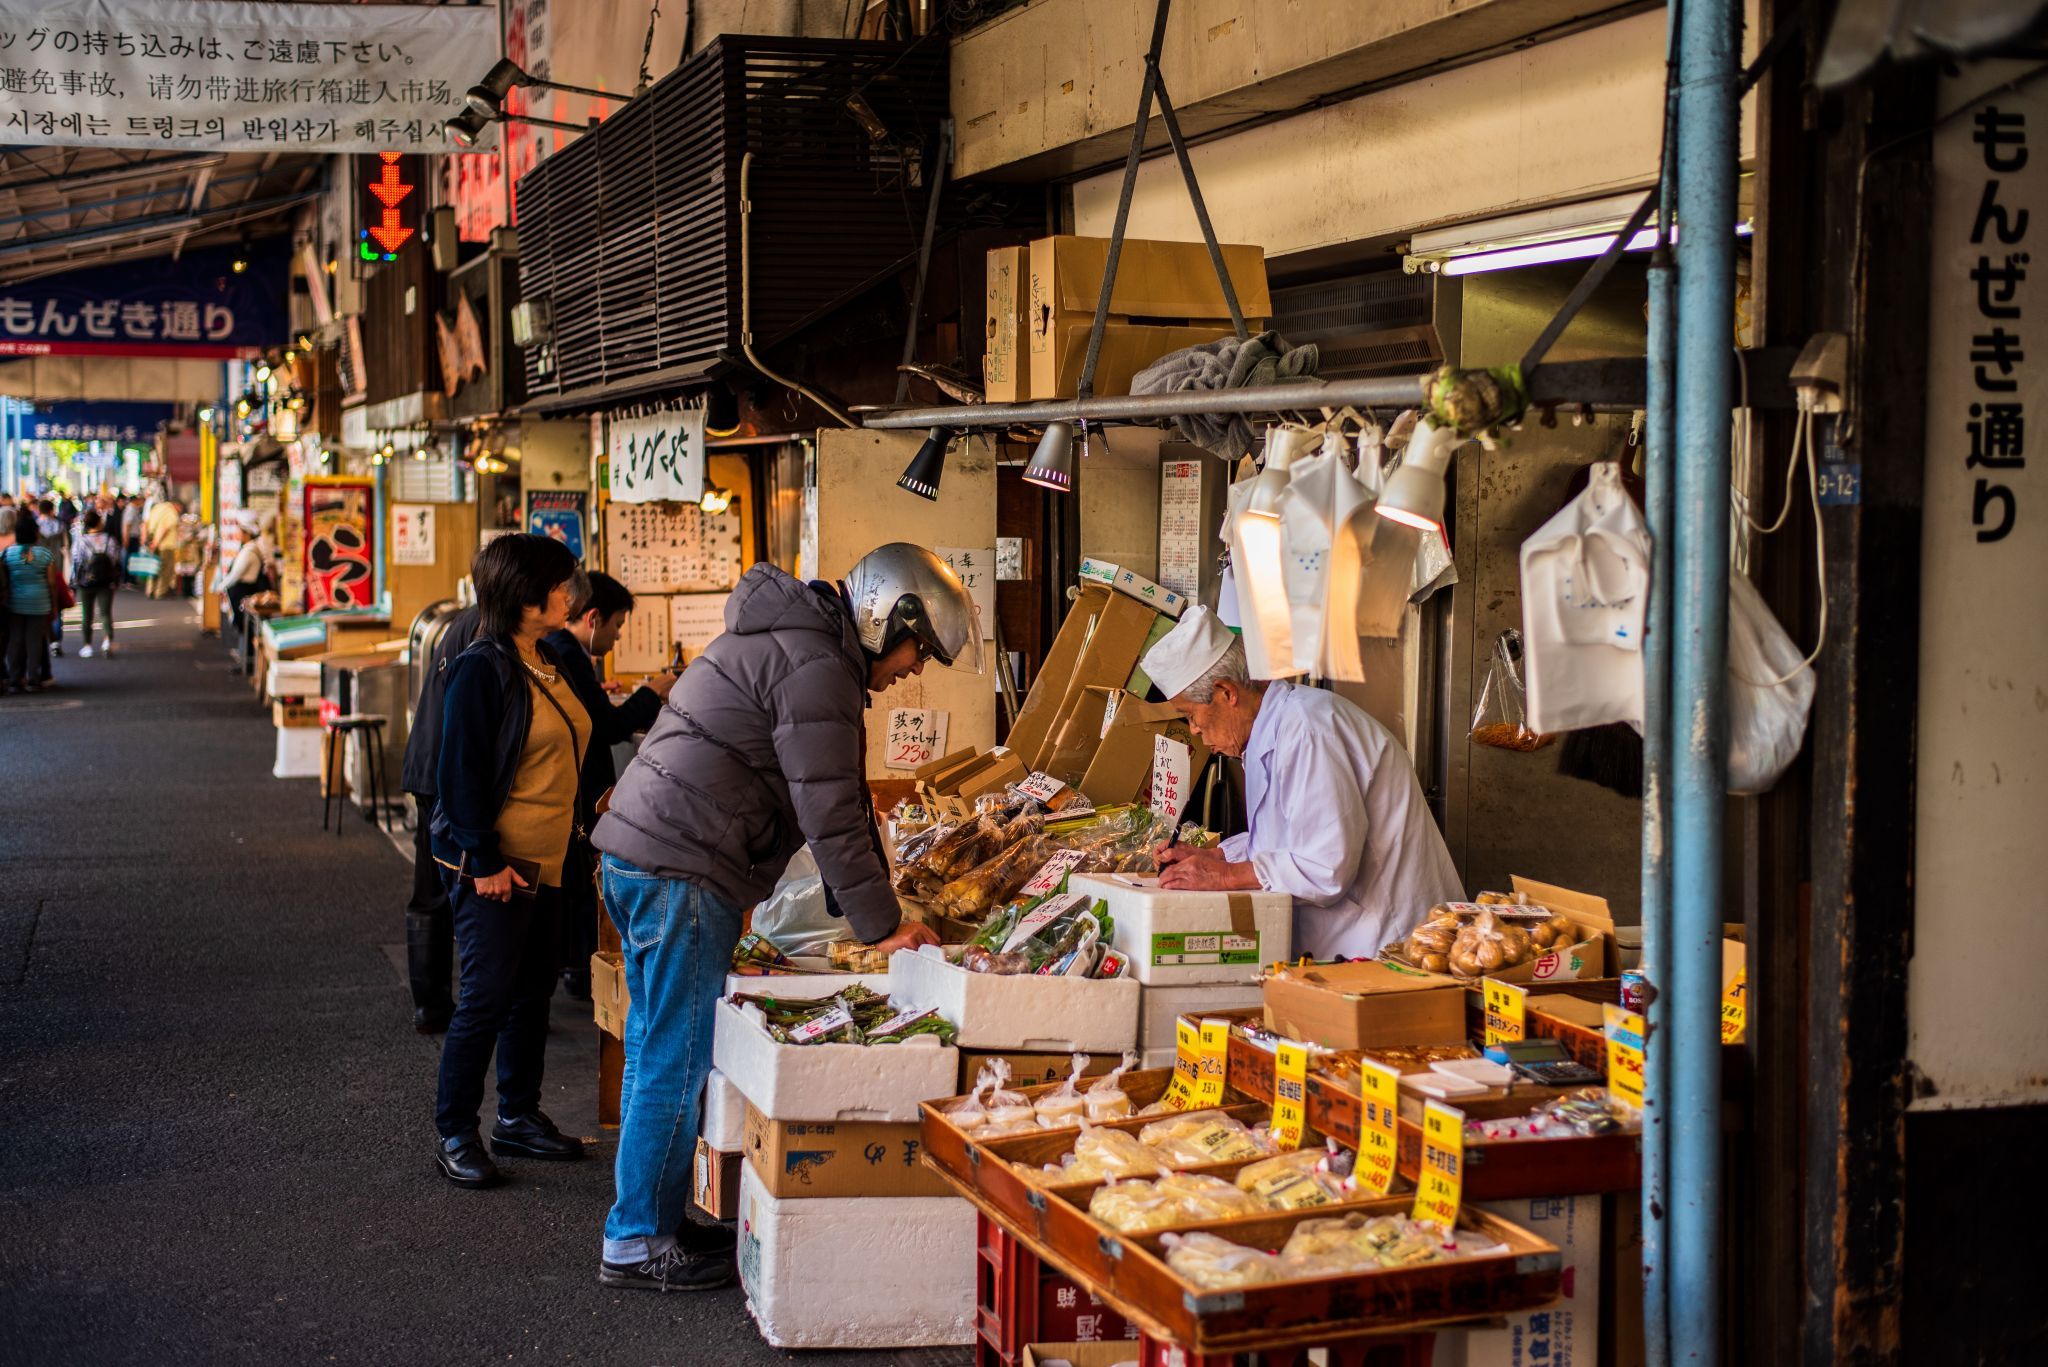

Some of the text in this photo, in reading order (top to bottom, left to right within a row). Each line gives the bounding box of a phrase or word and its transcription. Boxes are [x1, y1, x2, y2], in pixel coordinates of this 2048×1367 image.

[7, 109, 111, 137] 시장에는
[126, 115, 226, 141] 트렁크의
[243, 117, 341, 144] 반입삼가
[0, 298, 235, 340] もんぜき通り
[1966, 105, 2030, 543] もんぜき通り
[893, 744, 931, 763] 230
[1200, 1056, 1223, 1075] うどん
